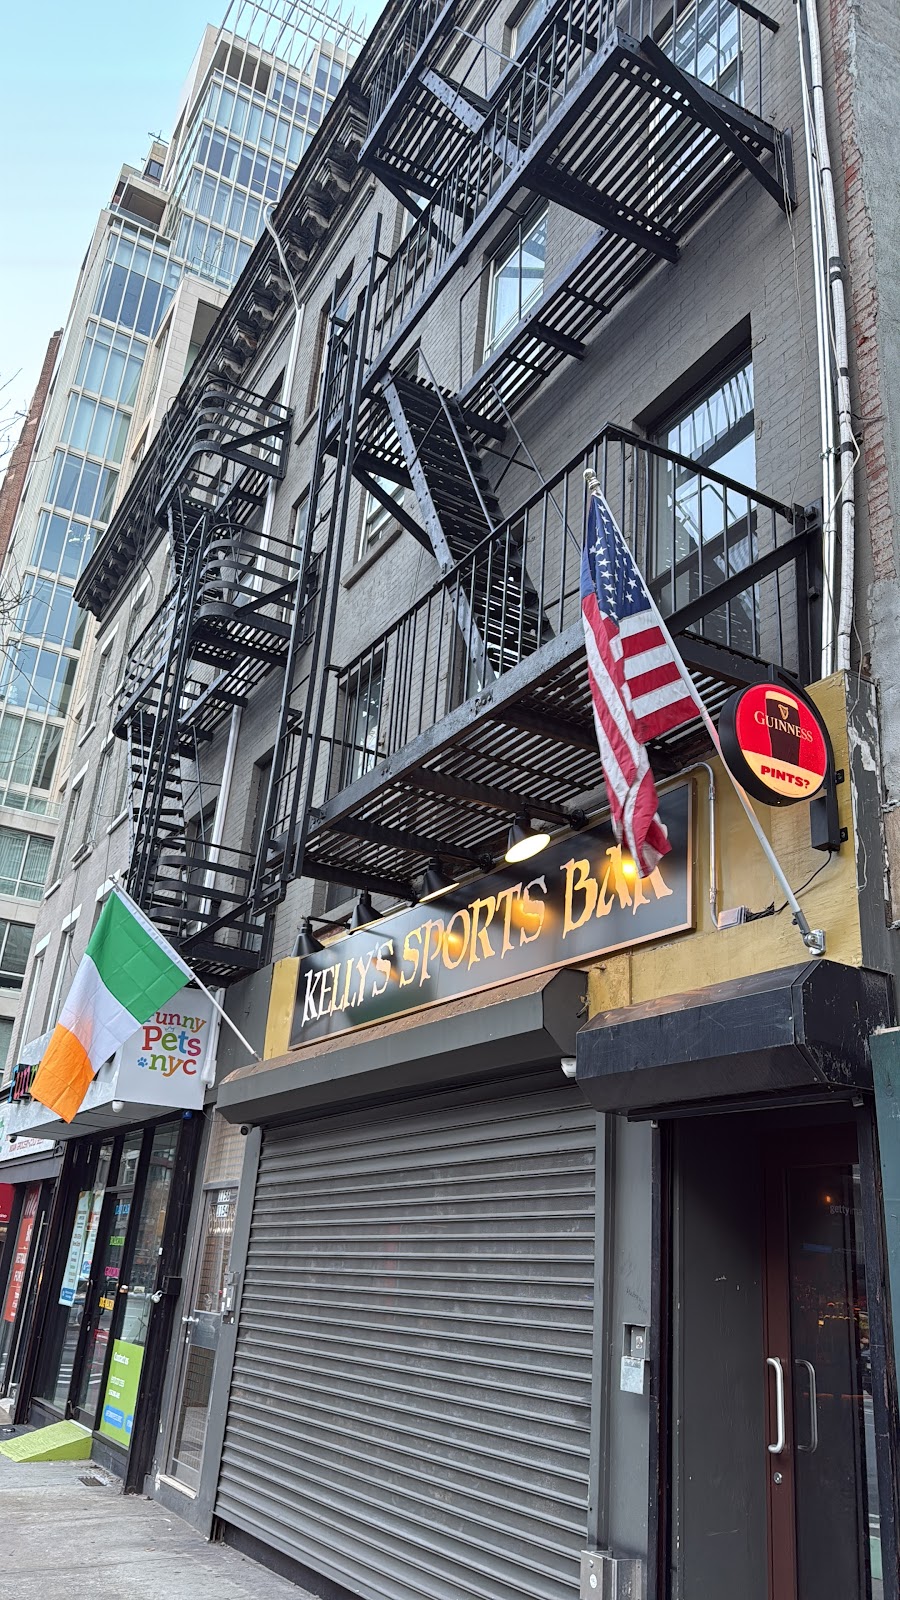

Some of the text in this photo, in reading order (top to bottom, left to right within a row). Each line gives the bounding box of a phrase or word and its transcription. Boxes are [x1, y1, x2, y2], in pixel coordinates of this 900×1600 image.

[754, 710, 813, 742] GUINNESS
[760, 764, 810, 789] PINTS?
[301, 938, 394, 1028] KELLY'S
[398, 874, 548, 989] SPORTS
[146, 1011, 206, 1033] unny
[142, 1026, 201, 1056] Pets
[149, 1054, 197, 1077] nyc
